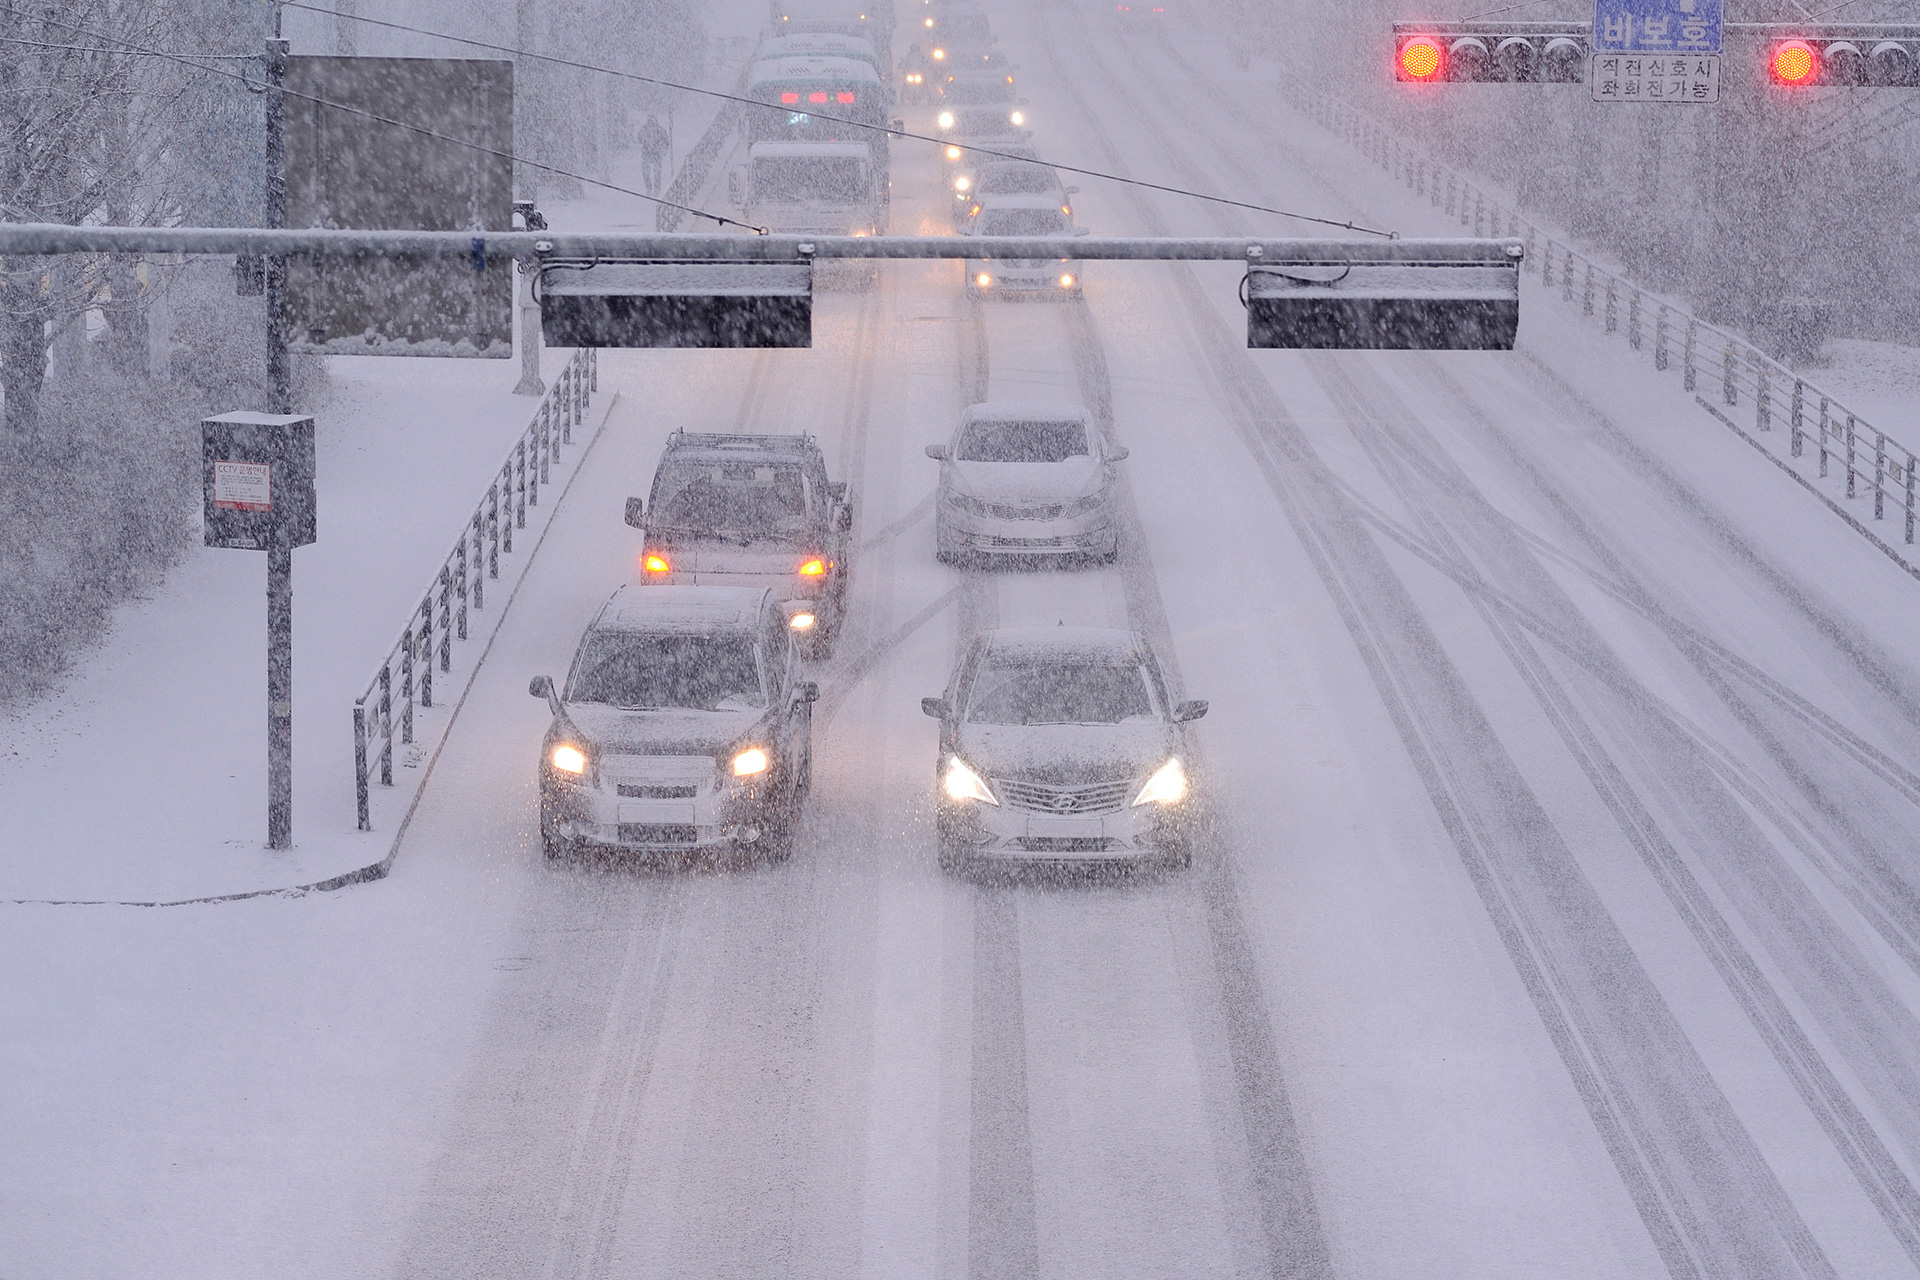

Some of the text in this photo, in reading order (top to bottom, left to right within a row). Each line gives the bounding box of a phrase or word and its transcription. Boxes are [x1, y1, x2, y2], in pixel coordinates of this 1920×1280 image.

[1603, 13, 1710, 48] 비보호
[1602, 58, 1711, 78] 직진신호시
[1601, 78, 1710, 98] 좌회전가능
[218, 465, 267, 476] CCTV 운영안내
